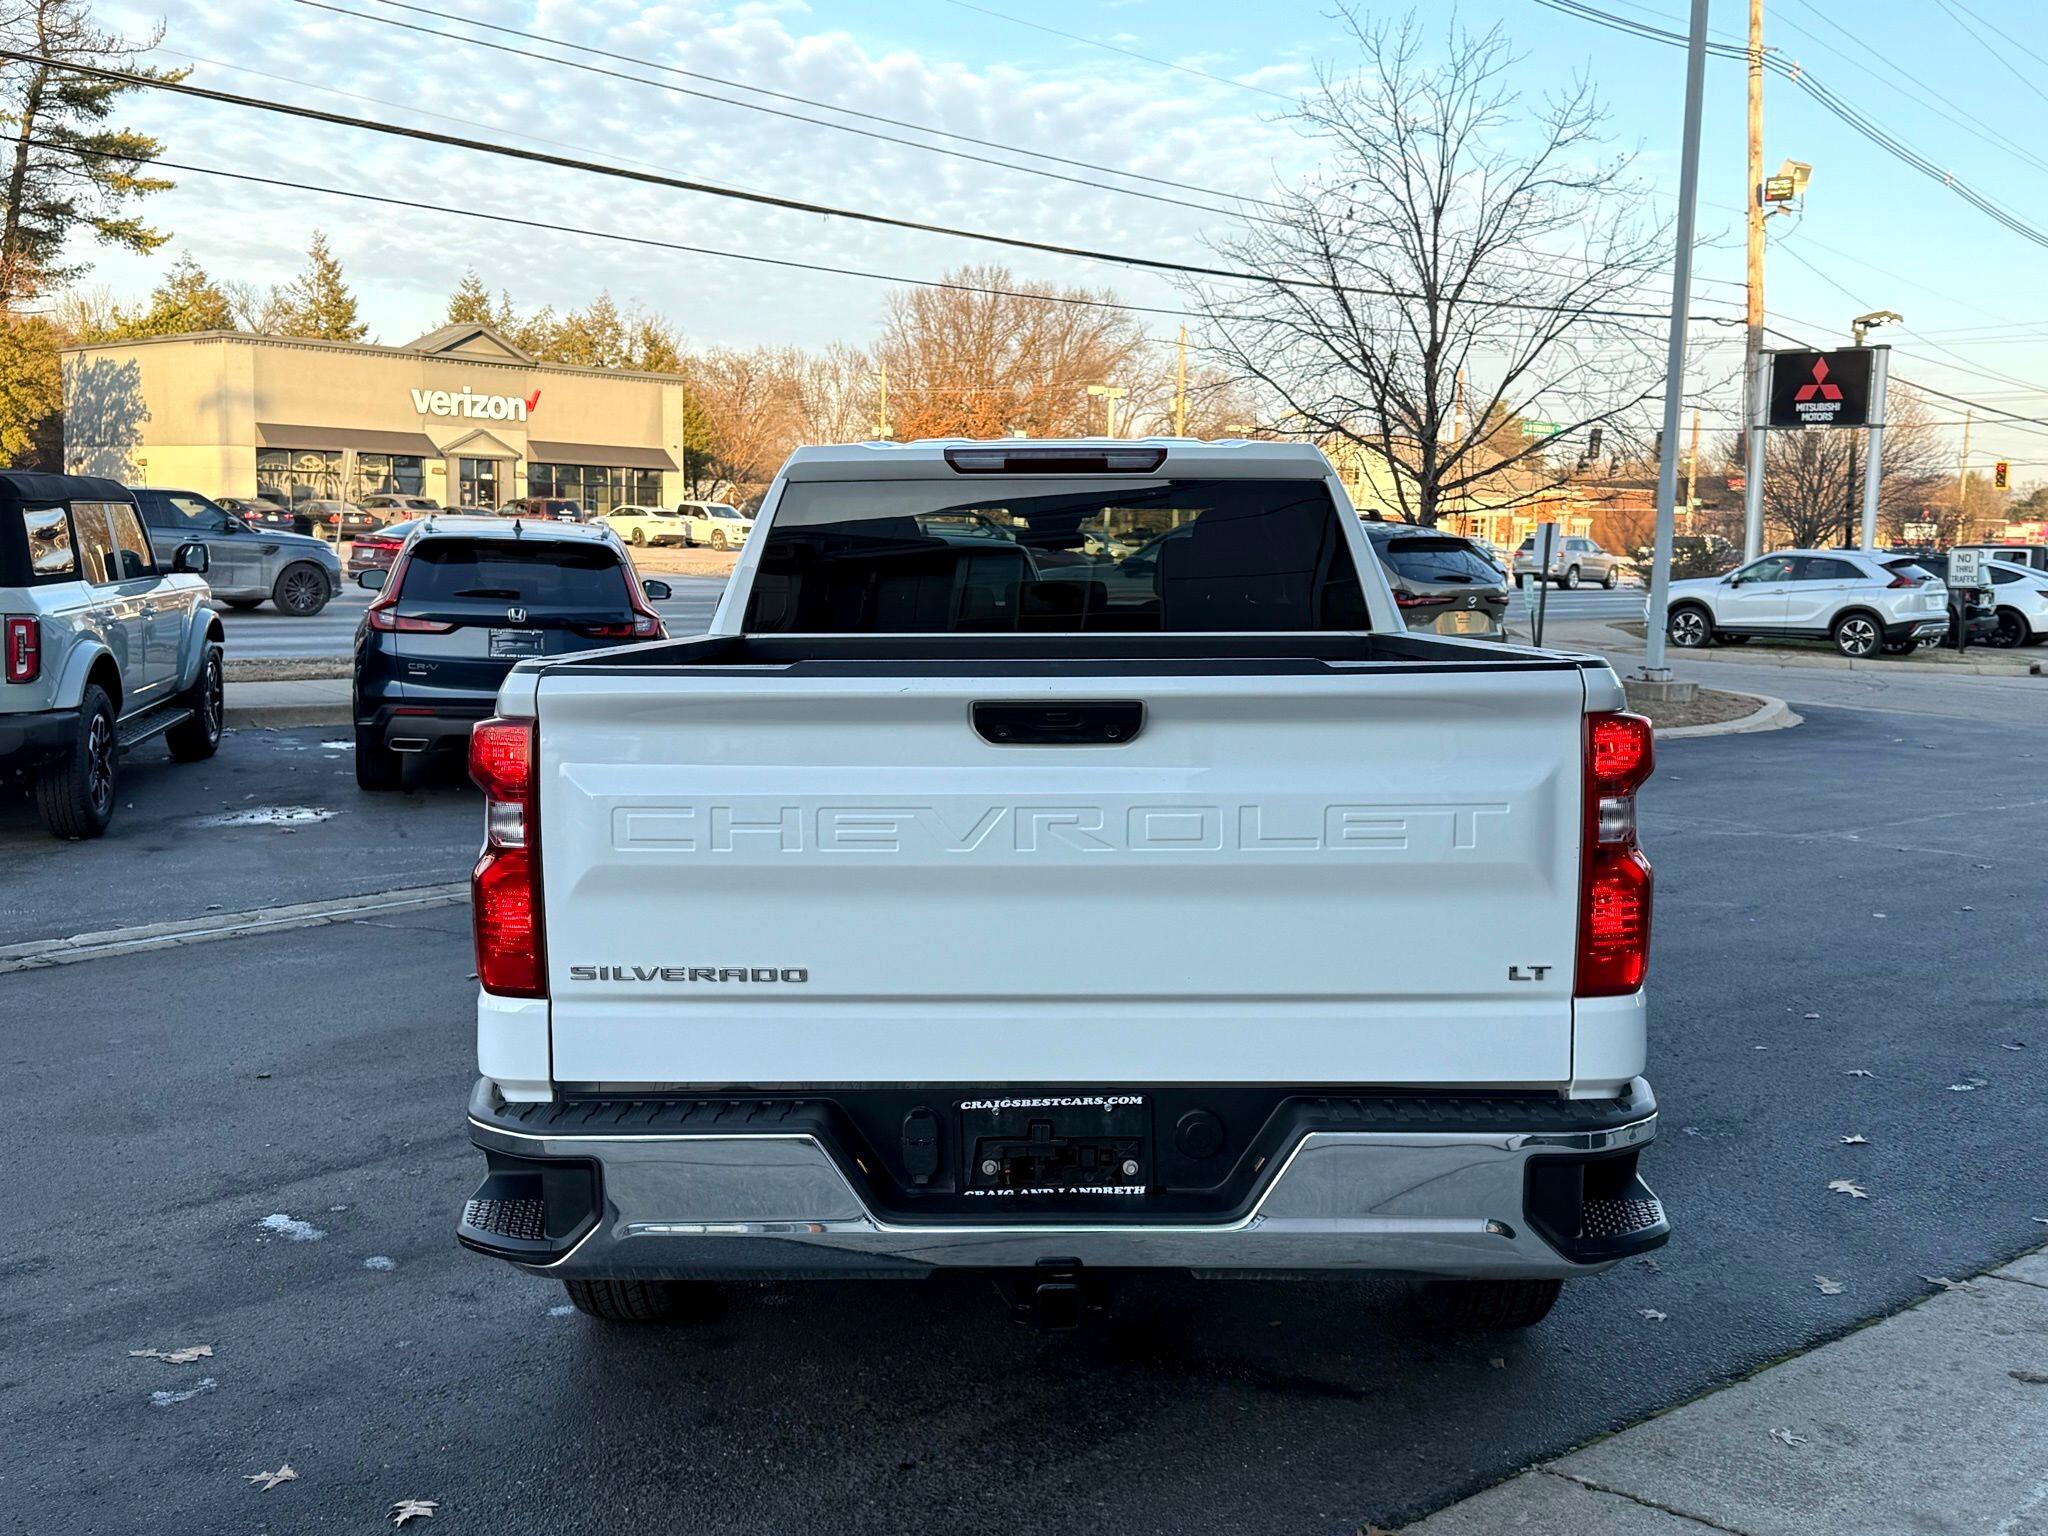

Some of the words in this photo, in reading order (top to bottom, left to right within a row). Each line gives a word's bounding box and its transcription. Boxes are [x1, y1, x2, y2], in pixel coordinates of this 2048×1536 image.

[411, 385, 527, 421] verizon
[1795, 402, 1841, 412] MITSUBISHI
[1801, 412, 1834, 421] MOTORS
[1957, 554, 1972, 563] NO
[1955, 565, 1974, 573] THRU
[1951, 575, 1978, 583] TRAFFIC
[610, 802, 1511, 852] CHEVROLET
[570, 965, 809, 983] SILVERADO
[1508, 966, 1552, 981] LT
[960, 1096, 1143, 1110] CRAIGSBESTCARS.COM
